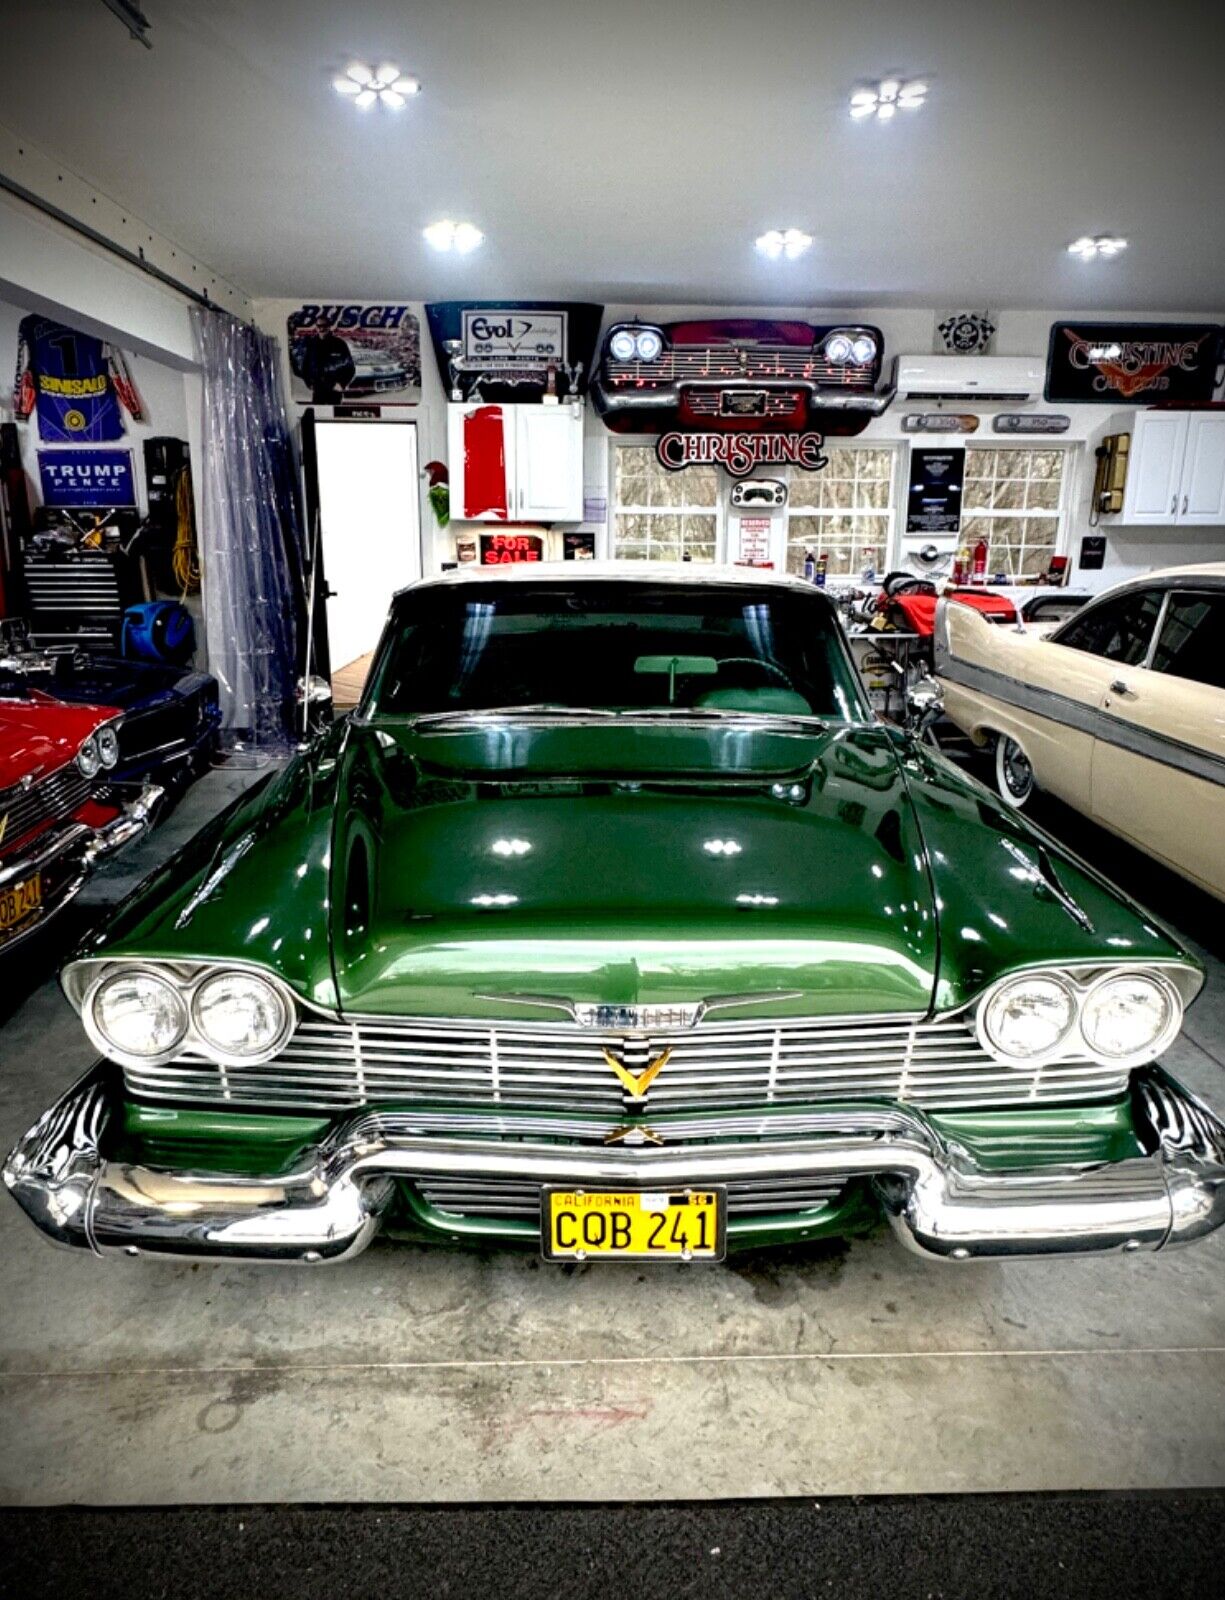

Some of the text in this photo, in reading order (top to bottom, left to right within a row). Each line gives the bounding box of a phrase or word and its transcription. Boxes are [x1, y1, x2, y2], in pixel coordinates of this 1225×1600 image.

[298, 305, 408, 329] BUSCH
[471, 317, 514, 341] Evol
[658, 432, 828, 475] CHRISTINE
[46, 465, 126, 477] TRUMP
[54, 478, 120, 487] PENCE
[491, 536, 530, 550] FOR
[485, 551, 538, 564] SALE
[555, 1195, 635, 1208] CALIFORNIA
[556, 1211, 712, 1249] CQB 241
